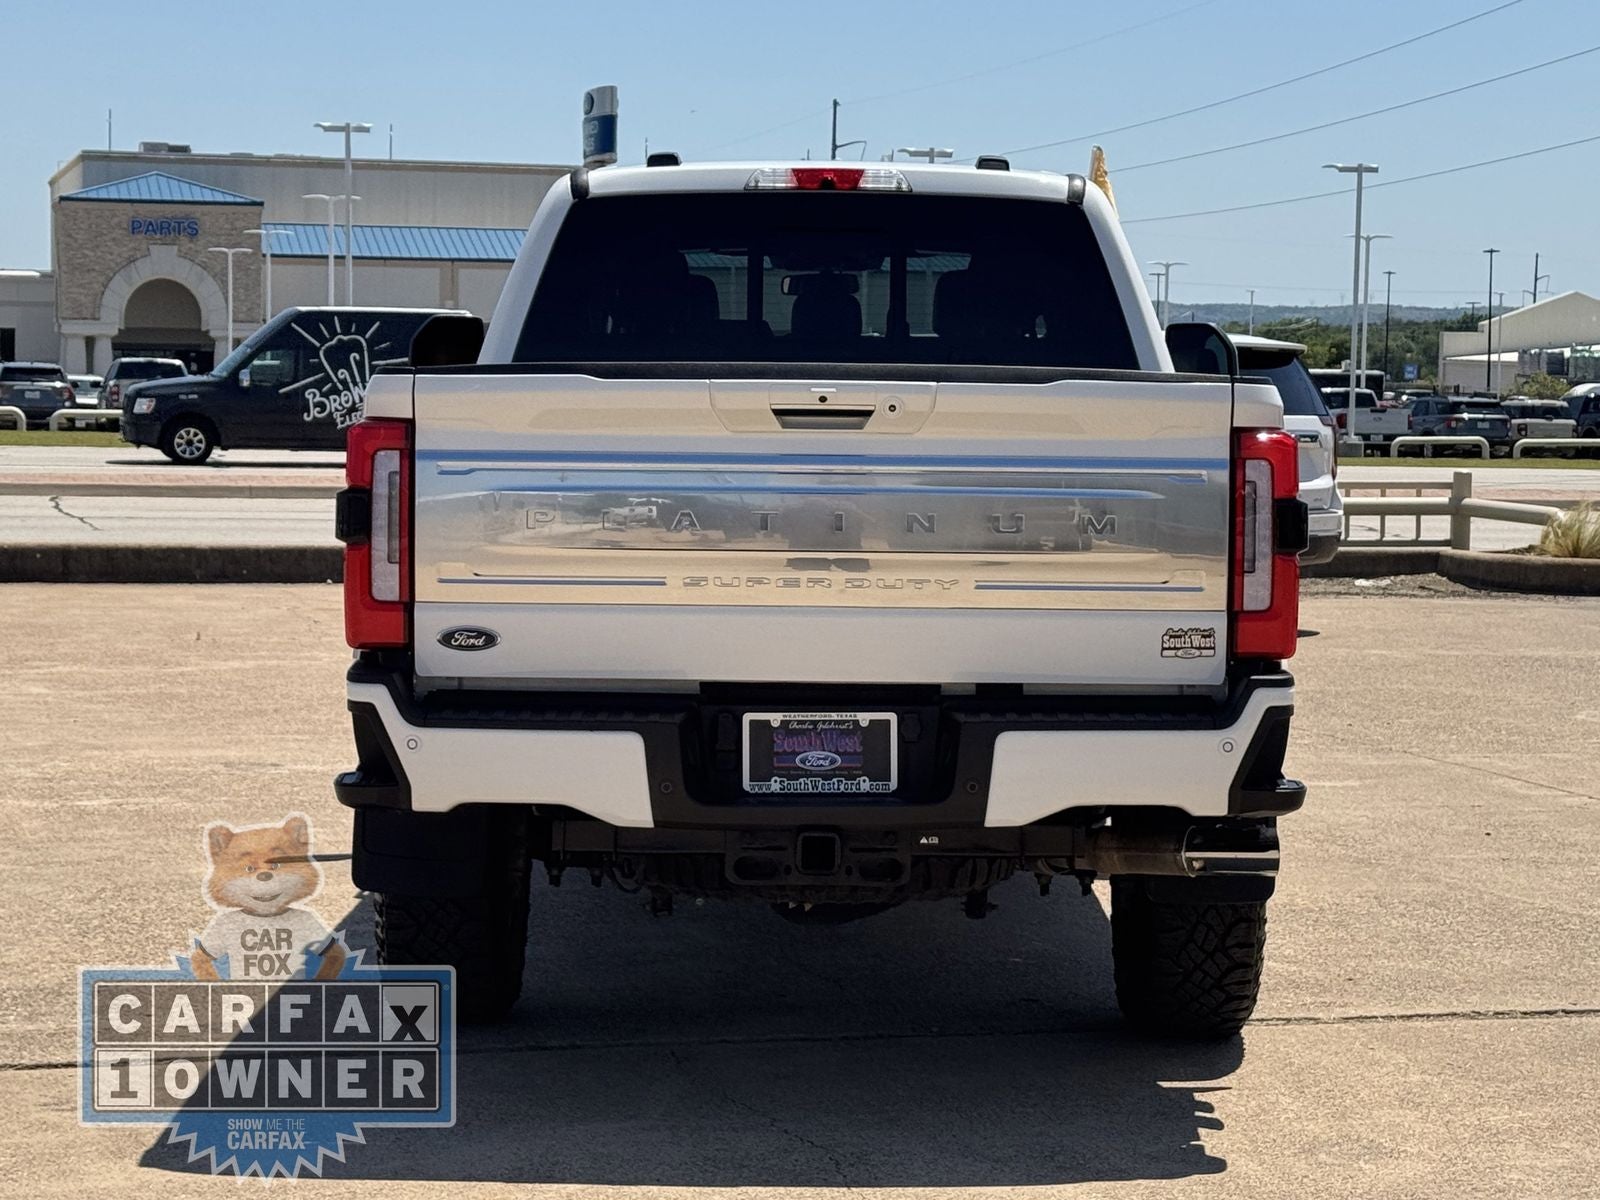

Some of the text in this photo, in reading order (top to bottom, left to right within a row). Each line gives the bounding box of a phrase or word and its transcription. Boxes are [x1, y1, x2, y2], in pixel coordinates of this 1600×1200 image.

[129, 217, 200, 237] PARTS
[525, 508, 1119, 536] PLATINUM
[682, 575, 960, 590] SUPER DUTY
[451, 630, 486, 646] Ford
[1162, 634, 1215, 648] SouthWest
[805, 753, 831, 767] Ford
